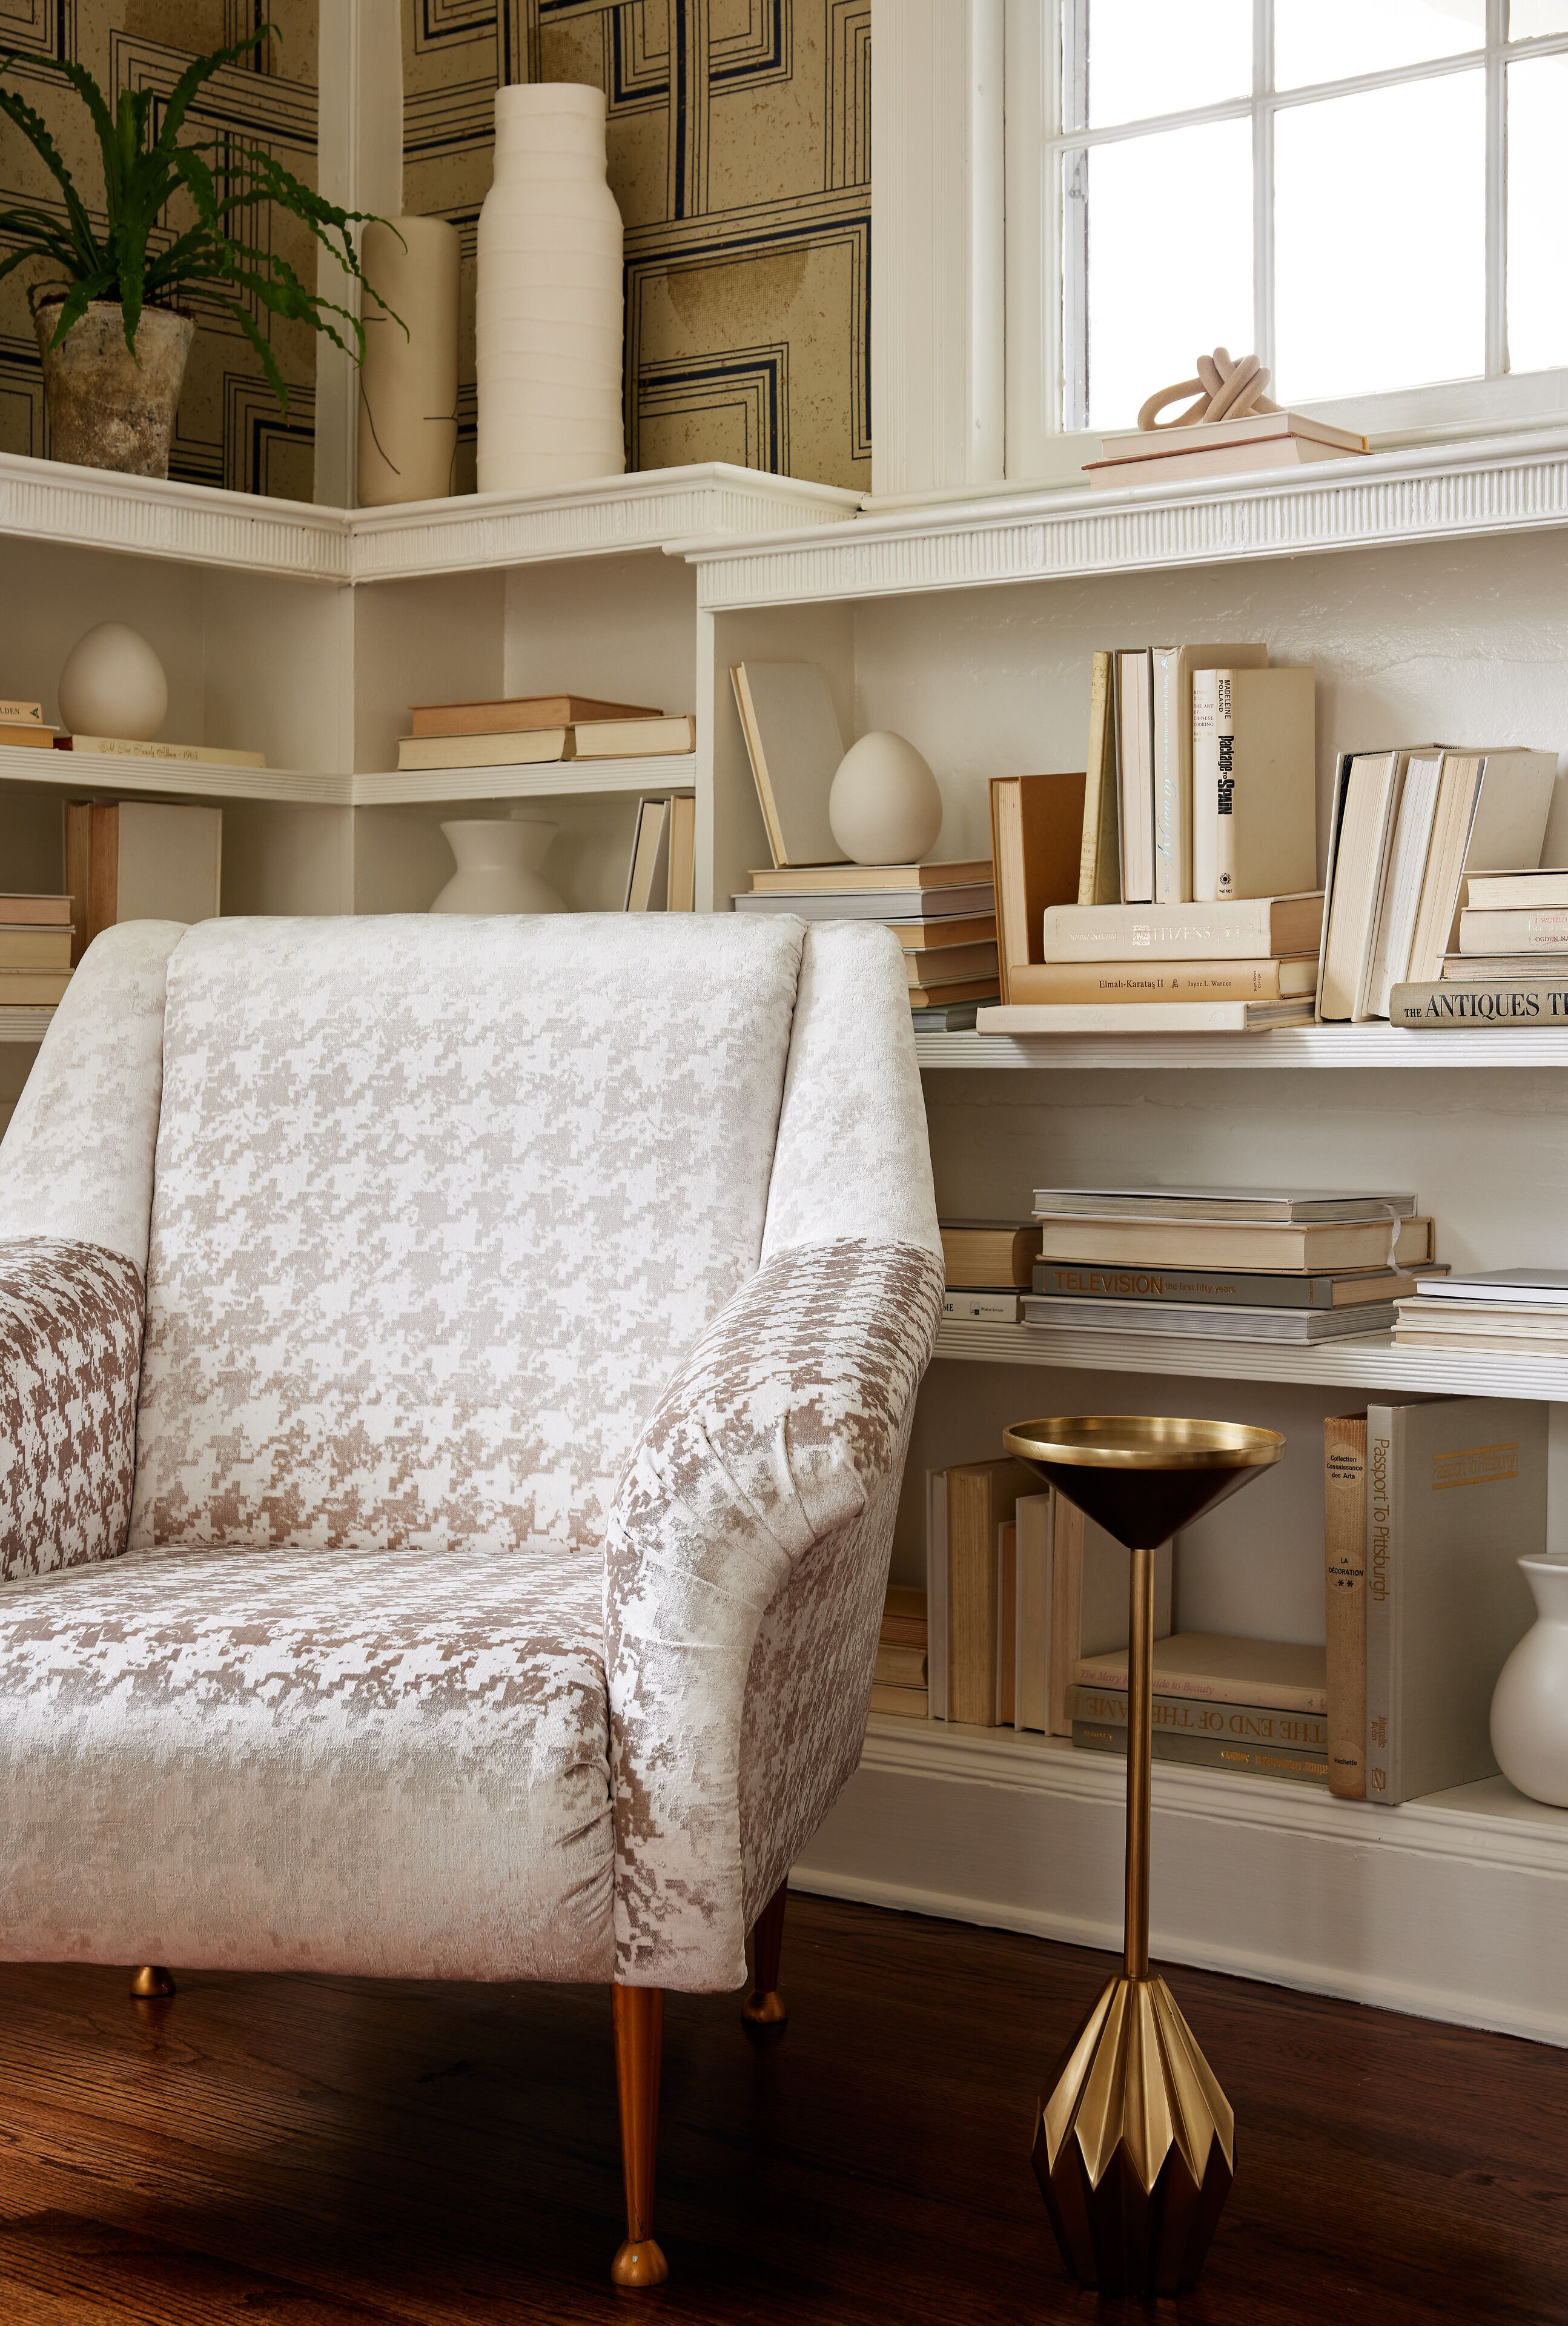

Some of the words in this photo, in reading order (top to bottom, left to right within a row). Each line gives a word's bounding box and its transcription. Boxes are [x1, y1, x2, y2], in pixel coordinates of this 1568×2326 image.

[1068, 931, 1090, 941] Simon
[1157, 979, 1163, 988] II
[1404, 1008, 1422, 1018] THE
[1424, 993, 1540, 1021] ANTIQUES
[1054, 1271, 1163, 1294] TELEVISION
[1165, 1281, 1177, 1291] the
[1179, 1282, 1194, 1292] first
[1196, 1283, 1212, 1294] fifty
[1214, 1284, 1236, 1294] years
[1326, 1463, 1363, 1471] Connaissance
[1370, 1438, 1390, 1502] Passport
[1373, 1505, 1390, 1522] To
[1328, 1566, 1364, 1577] DÉCORATION
[1369, 1526, 1391, 1602] Pittsburgh
[1080, 1668, 1097, 1682] The
[1099, 1671, 1122, 1687] Mary
[1151, 1678, 1171, 1690] uide
[1172, 1680, 1181, 1691] to
[1183, 1682, 1215, 1696] Beauty
[1085, 1695, 1128, 1720] AME
[1152, 1705, 1194, 1728] THE
[1199, 1710, 1224, 1732] OF
[1229, 1714, 1273, 1737] END
[1280, 1720, 1326, 1744] THE
[1378, 1717, 1387, 1749] Marcello
[1334, 1757, 1357, 1766] Hachette
